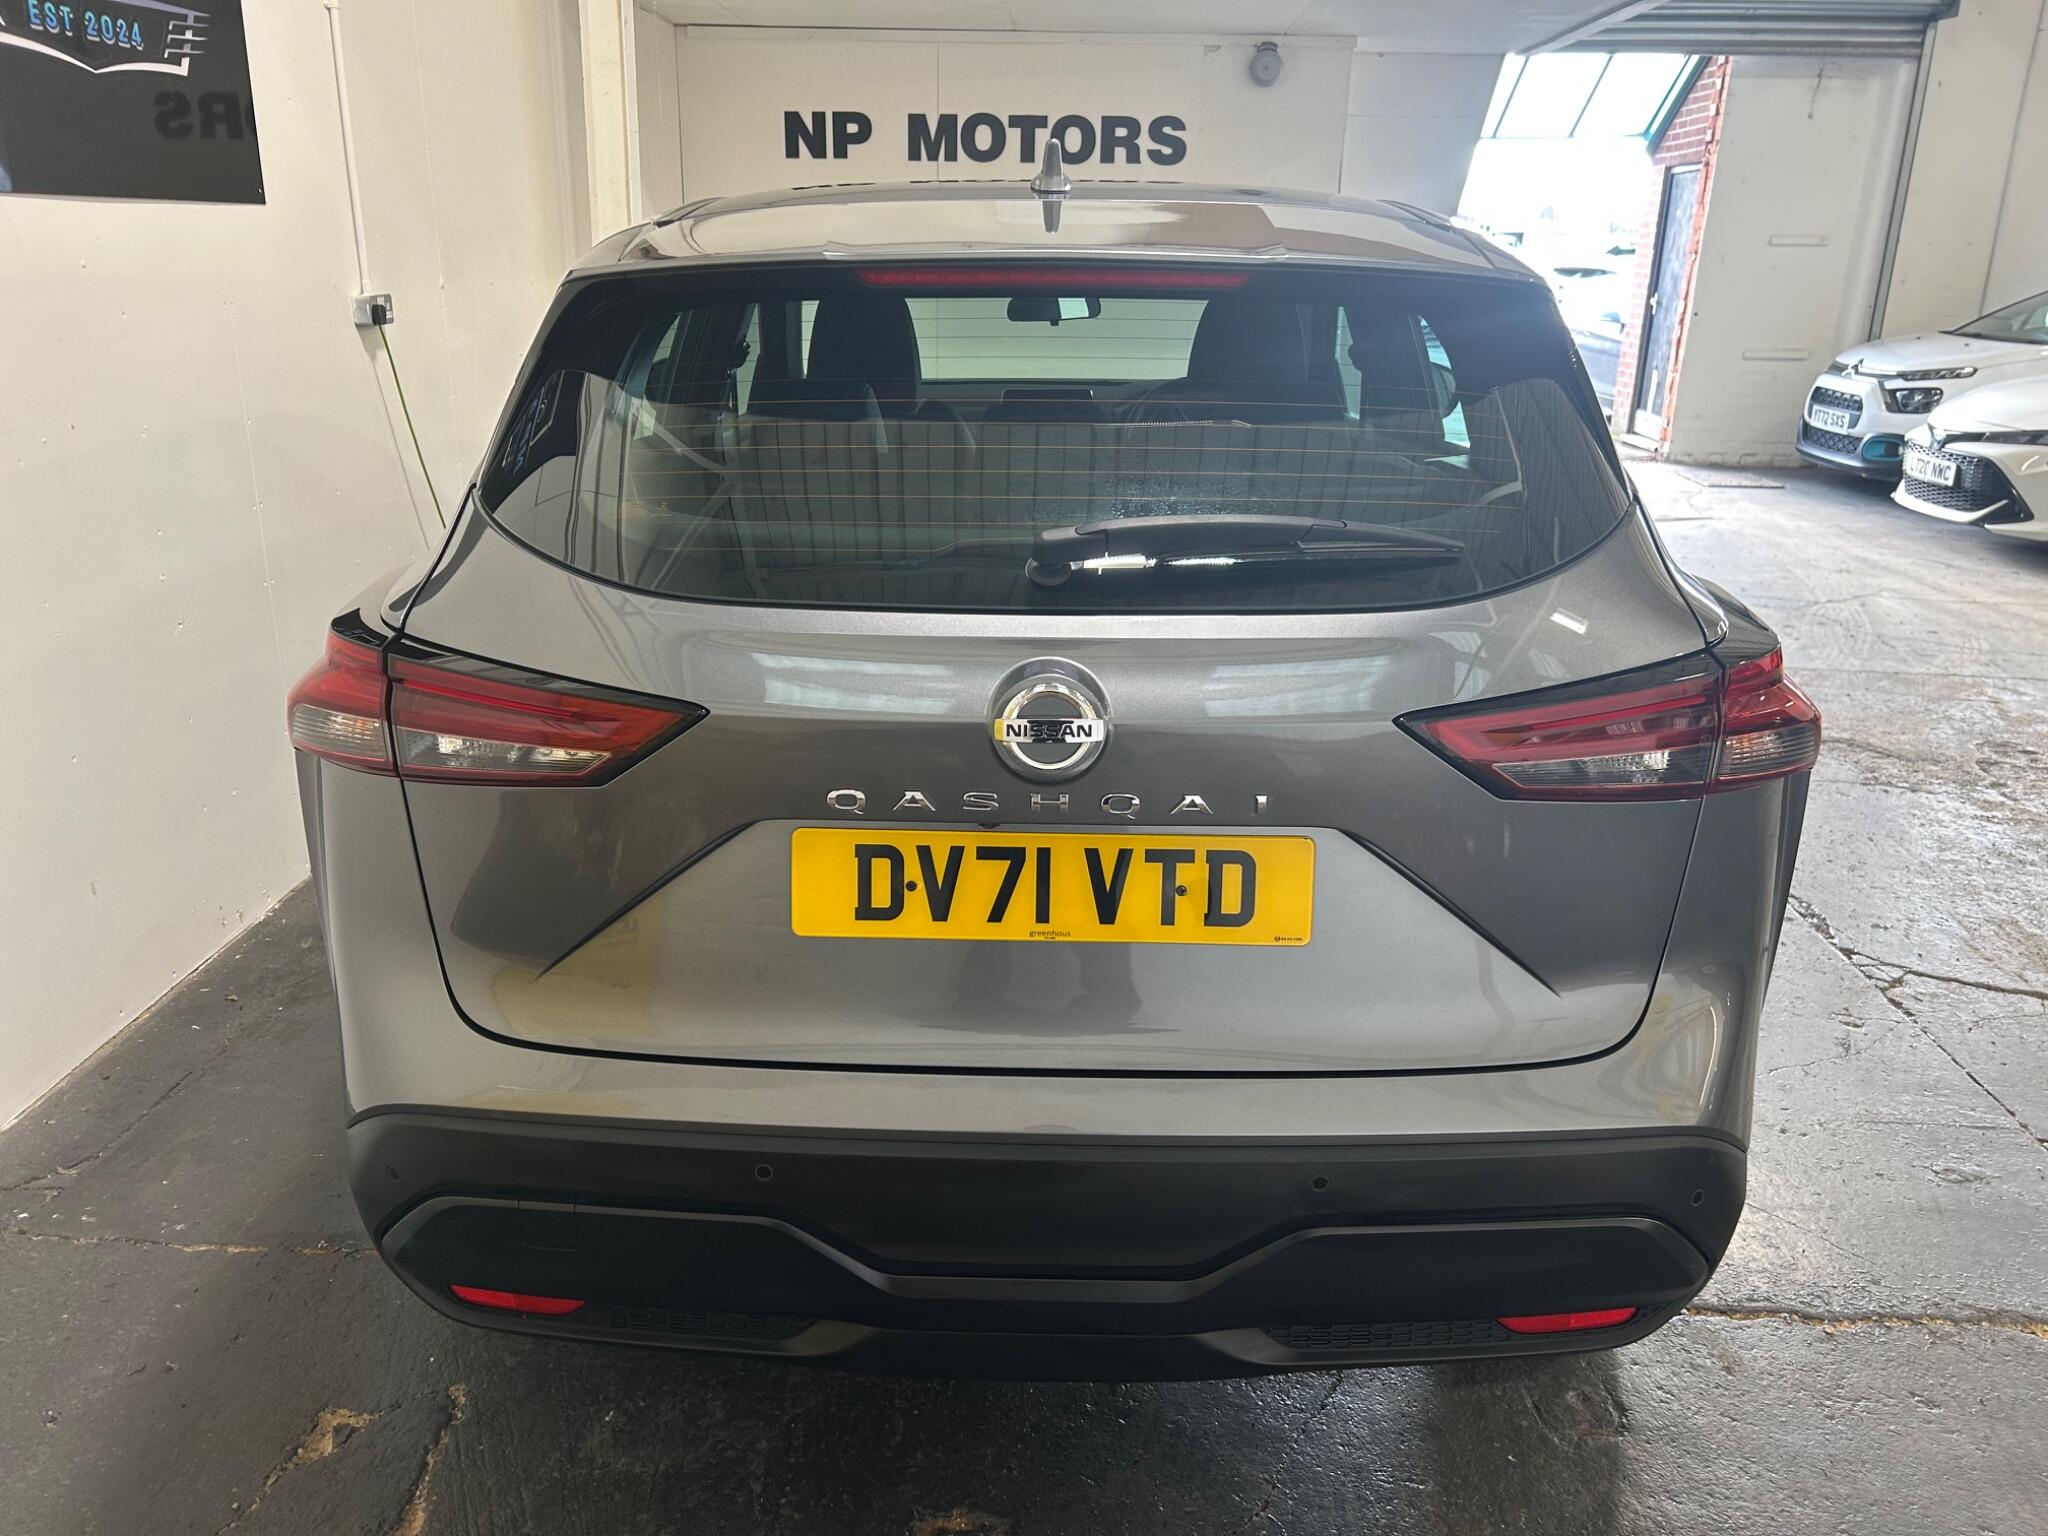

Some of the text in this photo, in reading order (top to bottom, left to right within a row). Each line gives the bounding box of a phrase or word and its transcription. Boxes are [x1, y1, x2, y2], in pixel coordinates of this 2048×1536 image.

[27, 0, 144, 51] EST 2024
[784, 111, 1187, 166] NP MOTORS
[1005, 723, 1092, 739] NISSAN
[826, 789, 1268, 820] QASHQAI
[854, 843, 1258, 927] DV71 VTD
